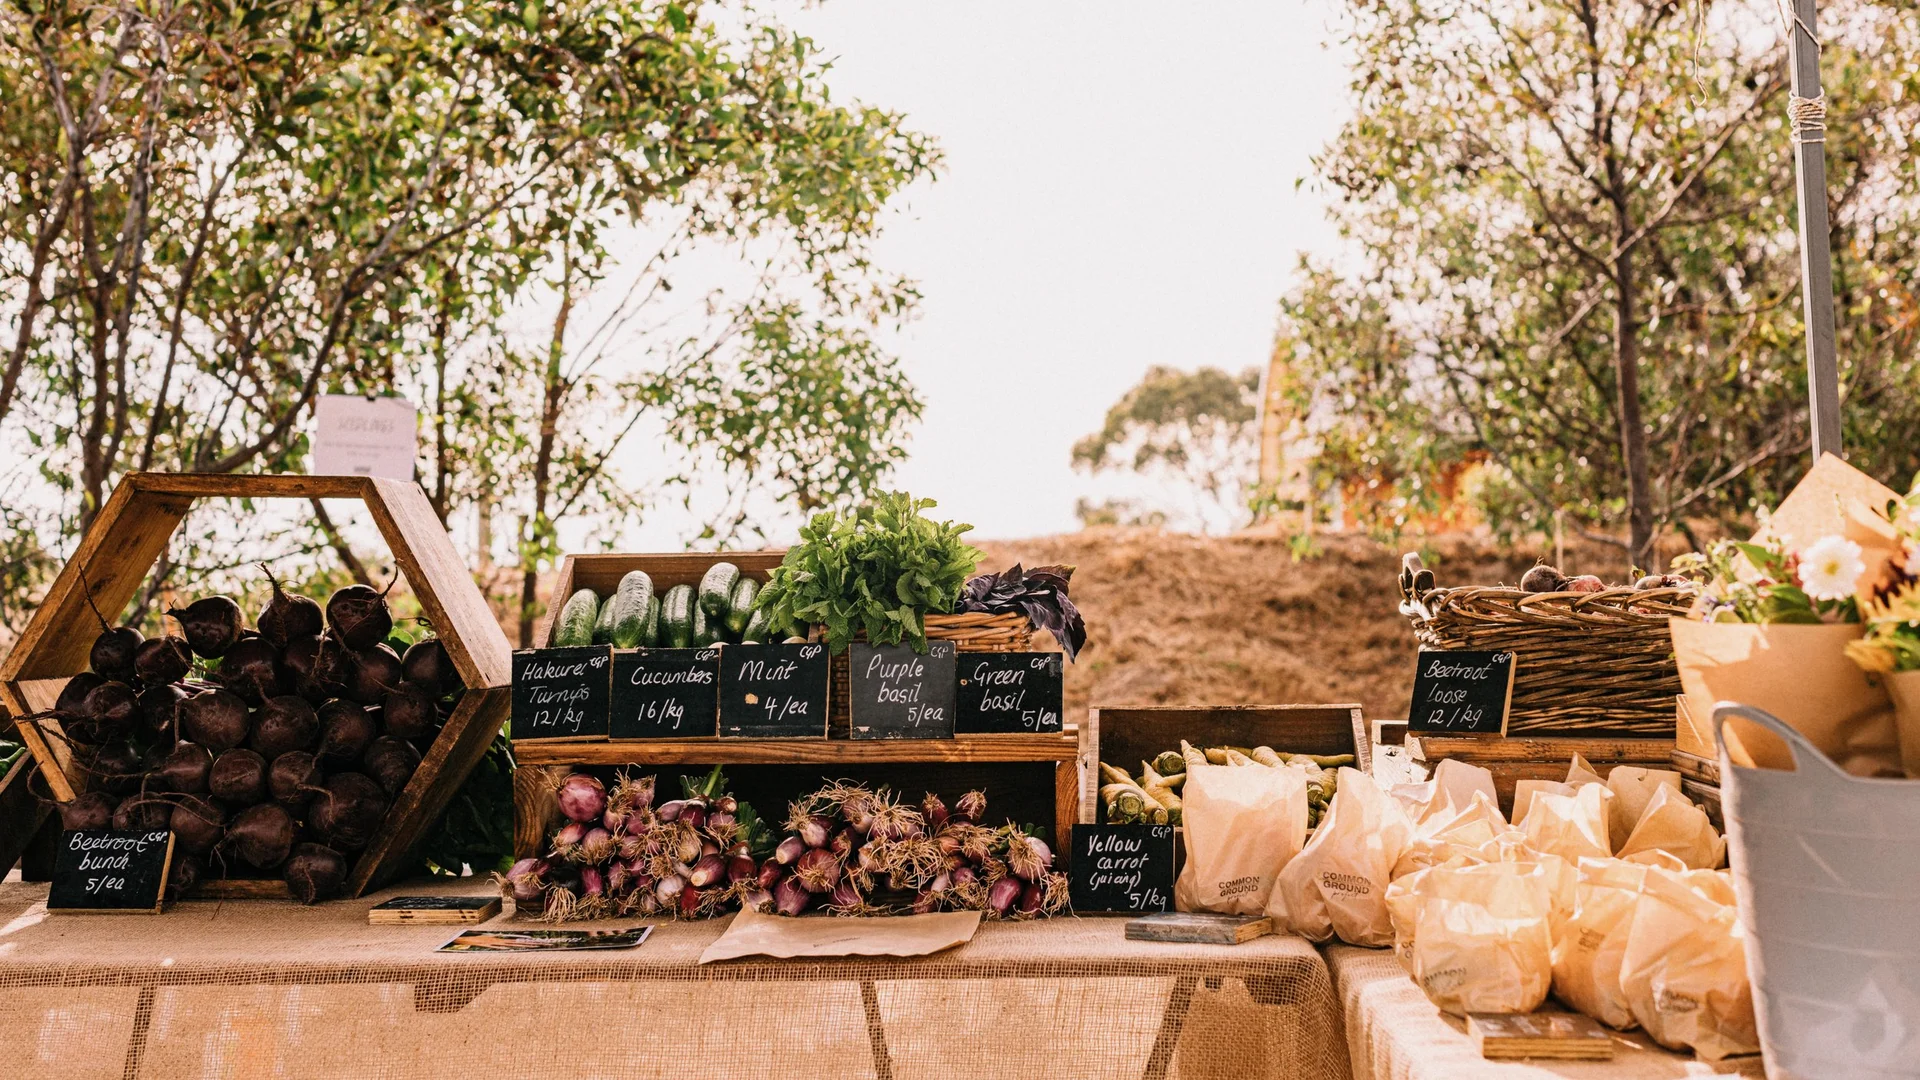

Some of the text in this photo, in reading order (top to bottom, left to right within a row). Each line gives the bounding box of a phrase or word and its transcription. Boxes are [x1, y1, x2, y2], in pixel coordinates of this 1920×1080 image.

[799, 645, 822, 660] CGP
[1030, 656, 1051, 670] CGP
[1491, 652, 1512, 664] CGP
[631, 665, 713, 686] Cucumbers
[738, 659, 798, 681] Mint
[866, 653, 924, 685] Purple
[973, 661, 1025, 687] Green
[1423, 659, 1494, 680] Beetroot
[529, 683, 590, 707] Turnips
[877, 681, 922, 704] basil
[980, 688, 1026, 712] basil
[533, 707, 584, 733] 12/kg
[638, 697, 684, 730] 16/kg
[907, 703, 944, 728] 5/ea
[1021, 707, 1058, 732] 5/ea
[1427, 704, 1483, 729] 12/kg
[69, 832, 149, 853] Beetroot
[1151, 826, 1171, 839] CGP
[1087, 834, 1142, 857] Yellow
[79, 851, 130, 871] bunch
[85, 875, 125, 895] 5/ea
[1218, 876, 1260, 889] COMMON
[1322, 871, 1372, 886] COMMON
[1323, 880, 1370, 895] GROUND
[1129, 887, 1167, 913] 5/kg
[1220, 884, 1259, 897] GROUND
